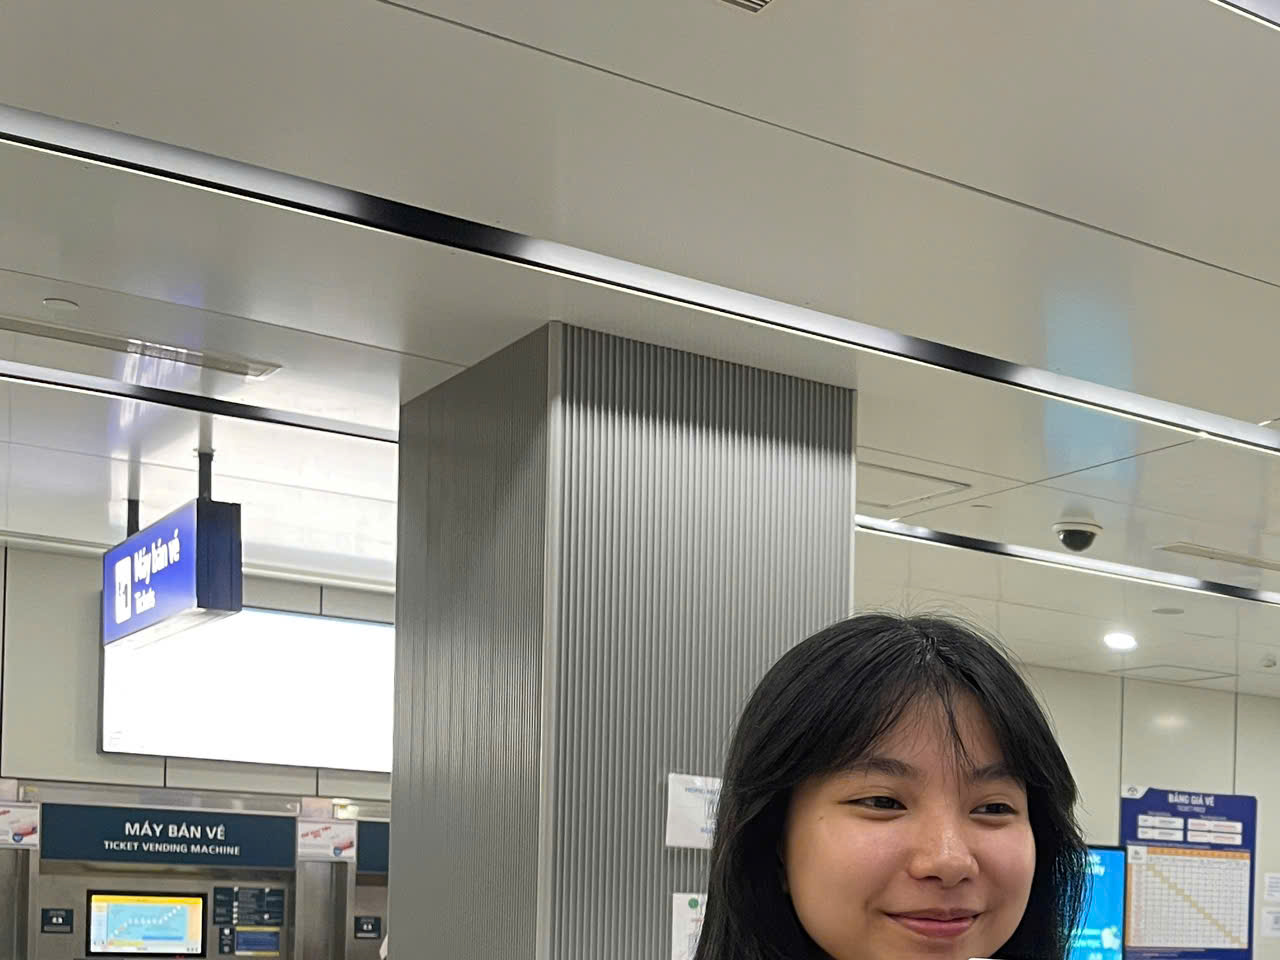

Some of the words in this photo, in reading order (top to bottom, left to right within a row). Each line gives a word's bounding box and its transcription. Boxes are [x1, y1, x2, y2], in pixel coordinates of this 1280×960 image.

[125, 820, 164, 838] MÁY
[168, 822, 202, 840] BÁN
[104, 840, 139, 852] TICKET
[142, 842, 188, 854] VENDING
[190, 844, 240, 857] MACHINE
